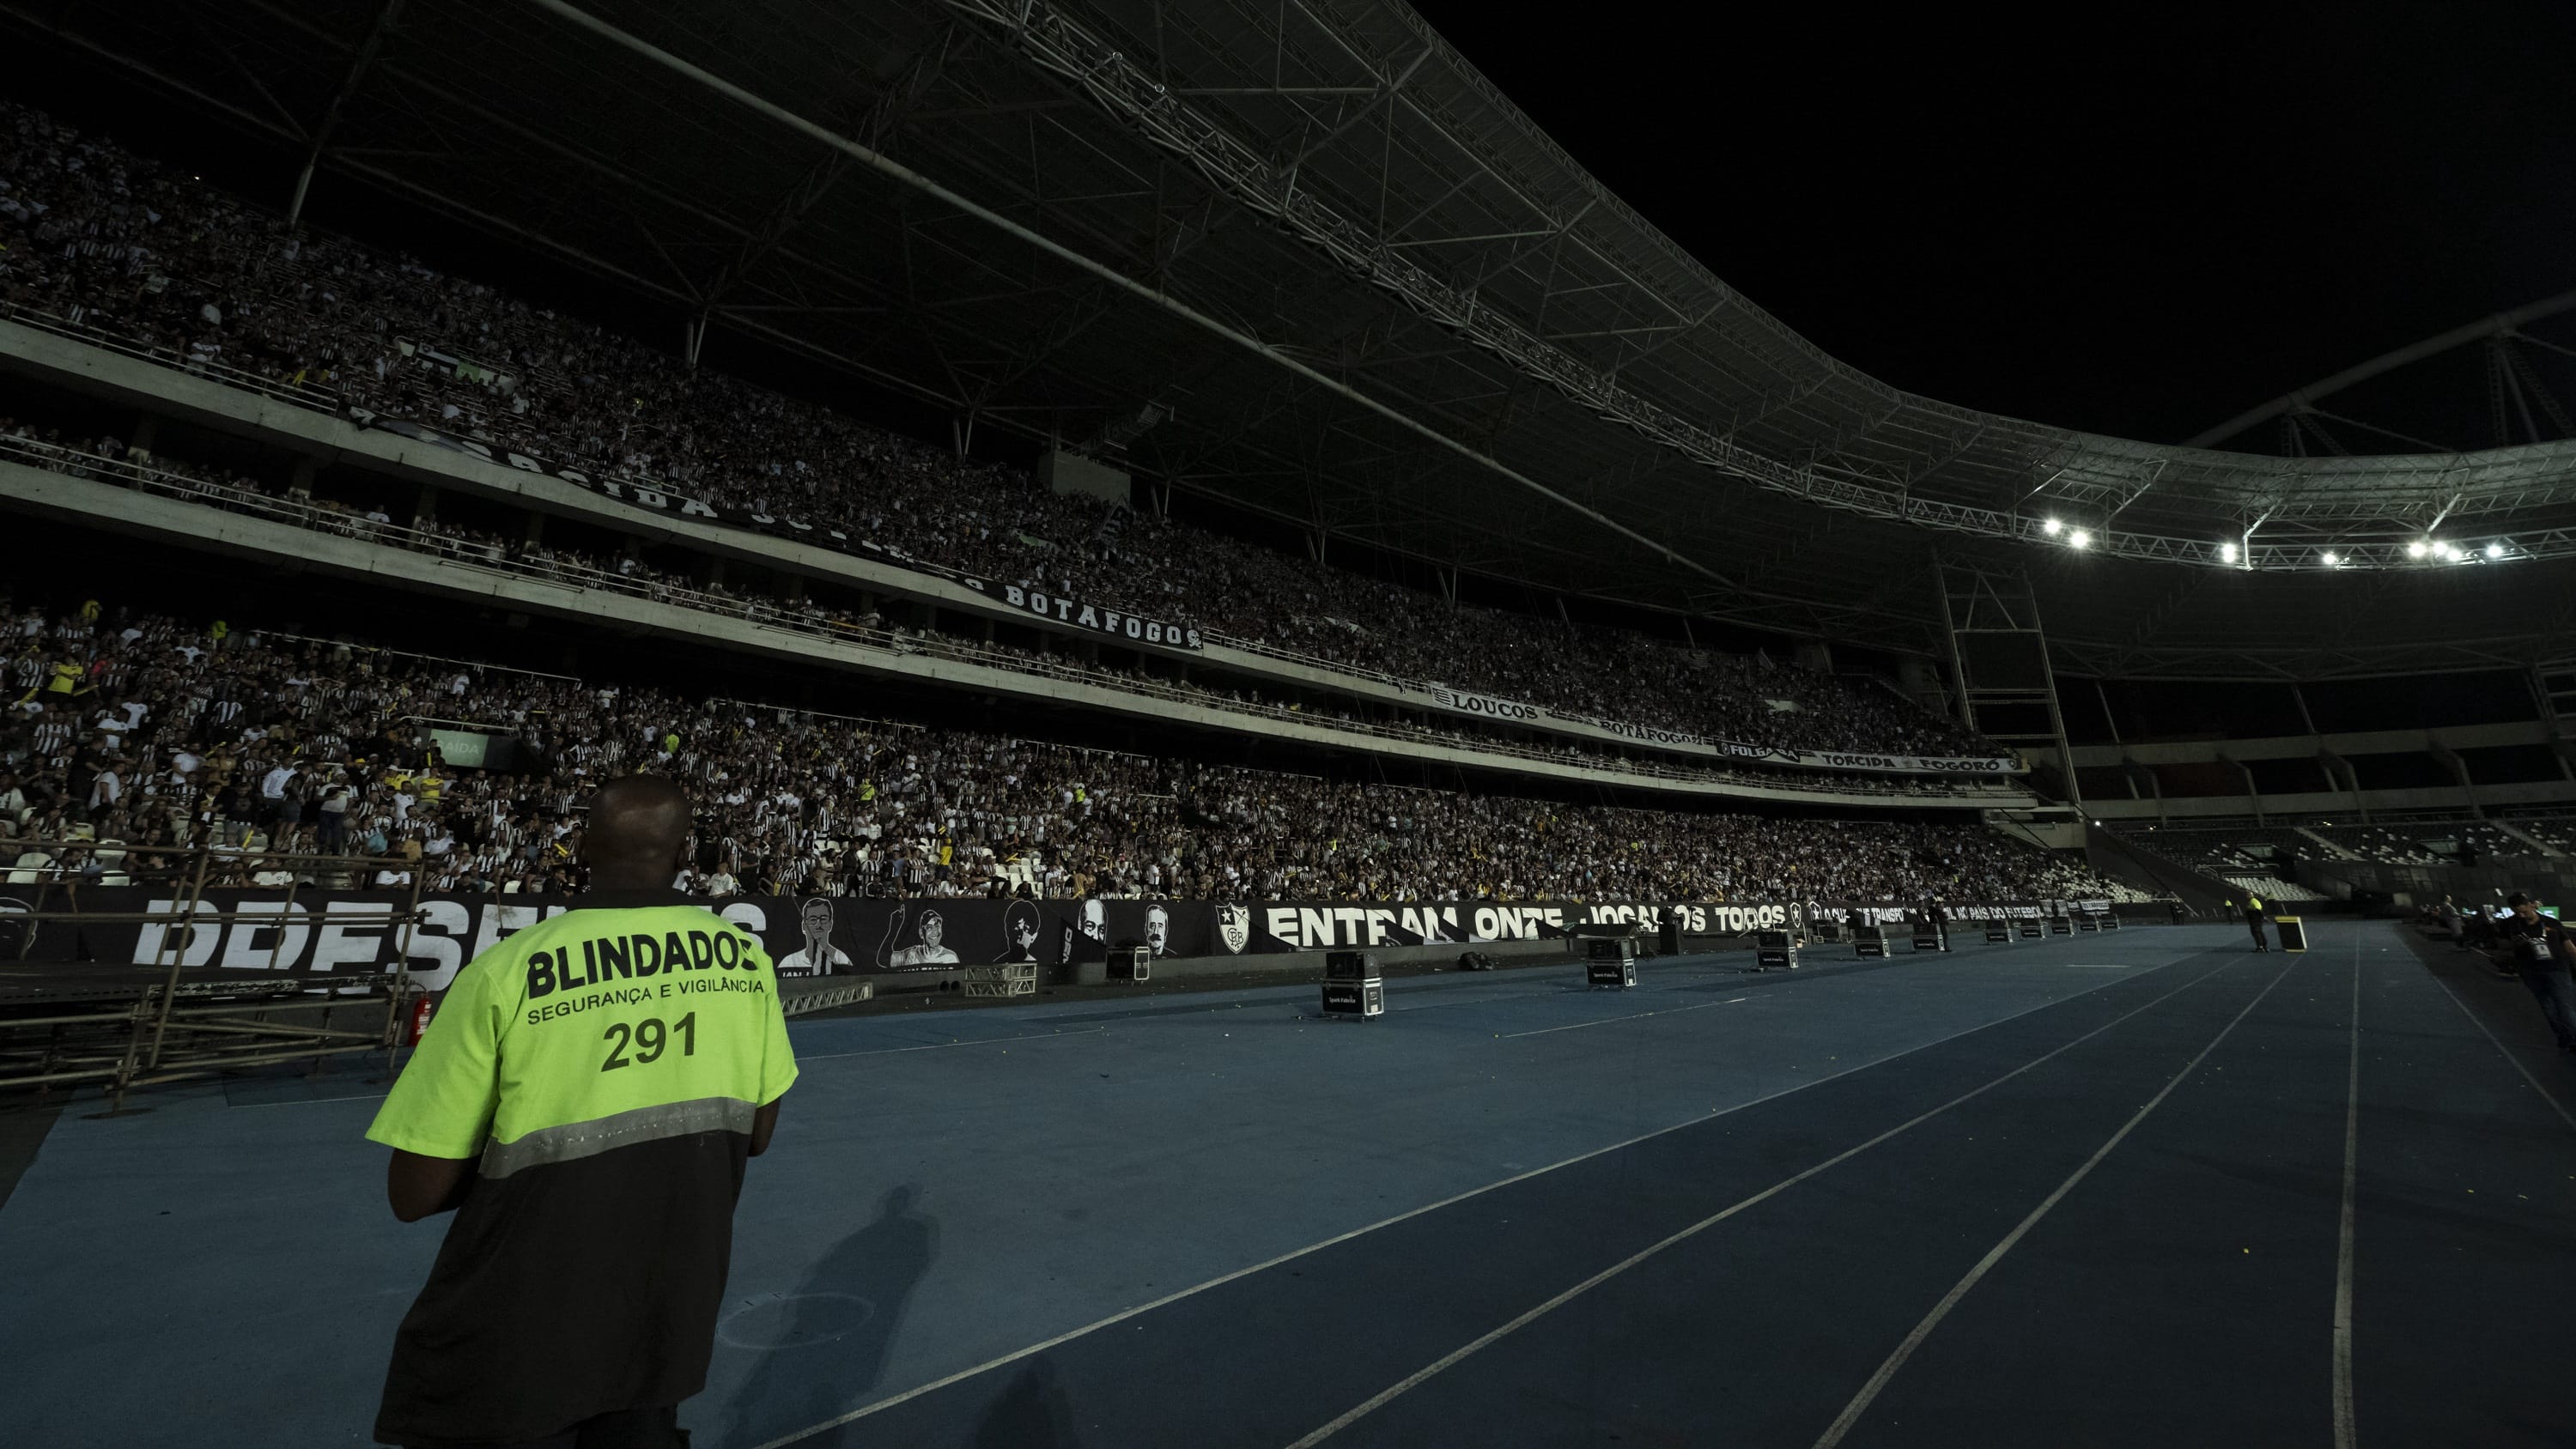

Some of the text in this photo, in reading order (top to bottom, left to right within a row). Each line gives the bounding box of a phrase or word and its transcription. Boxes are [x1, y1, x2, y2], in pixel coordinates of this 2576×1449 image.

[1005, 585, 1182, 645] BOTAFOGO
[1451, 694, 1538, 719] LOUCOS
[1821, 754, 2000, 771] TORCIDA FOGORÓ
[1715, 905, 1786, 931] TODOS
[527, 931, 758, 1000] BLINDADOS
[527, 976, 764, 1026] SEGURANÇA E VIGILÂNCIA
[601, 1011, 696, 1073] 291
